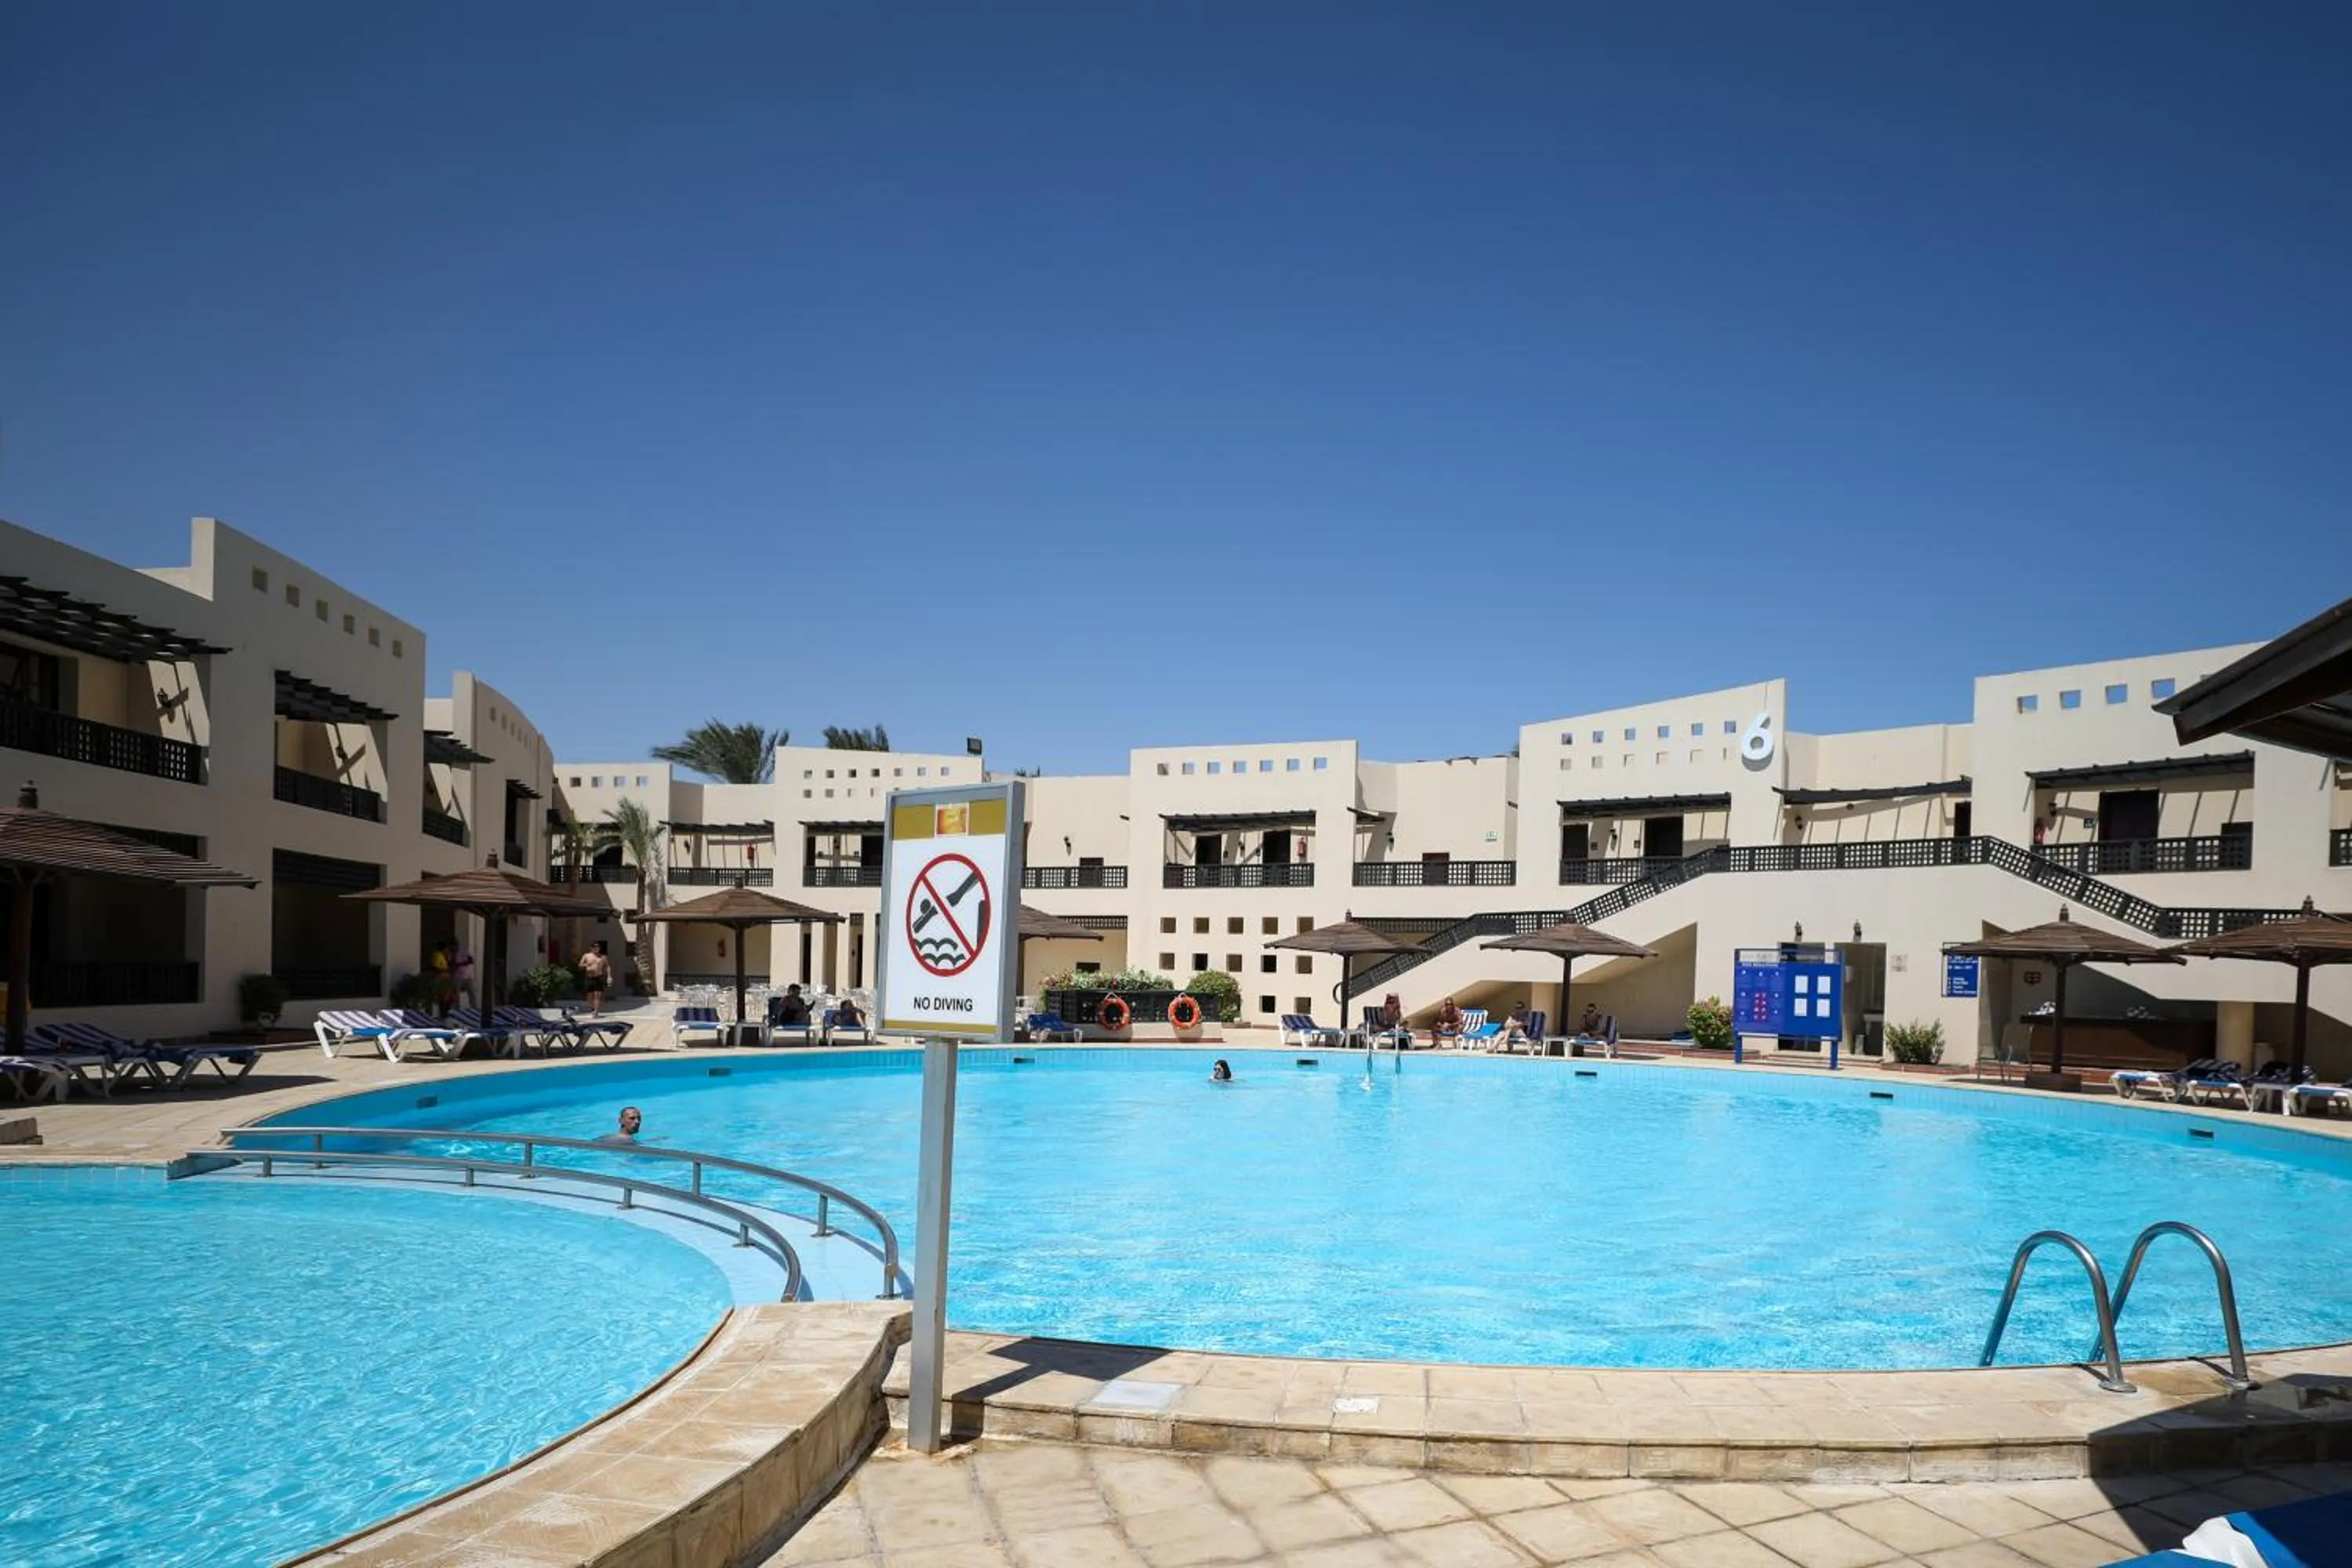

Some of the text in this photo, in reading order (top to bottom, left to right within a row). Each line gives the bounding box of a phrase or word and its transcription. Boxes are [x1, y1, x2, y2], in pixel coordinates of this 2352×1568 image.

[1741, 711, 1774, 762] 6
[913, 996, 973, 1012] NO DIVING
